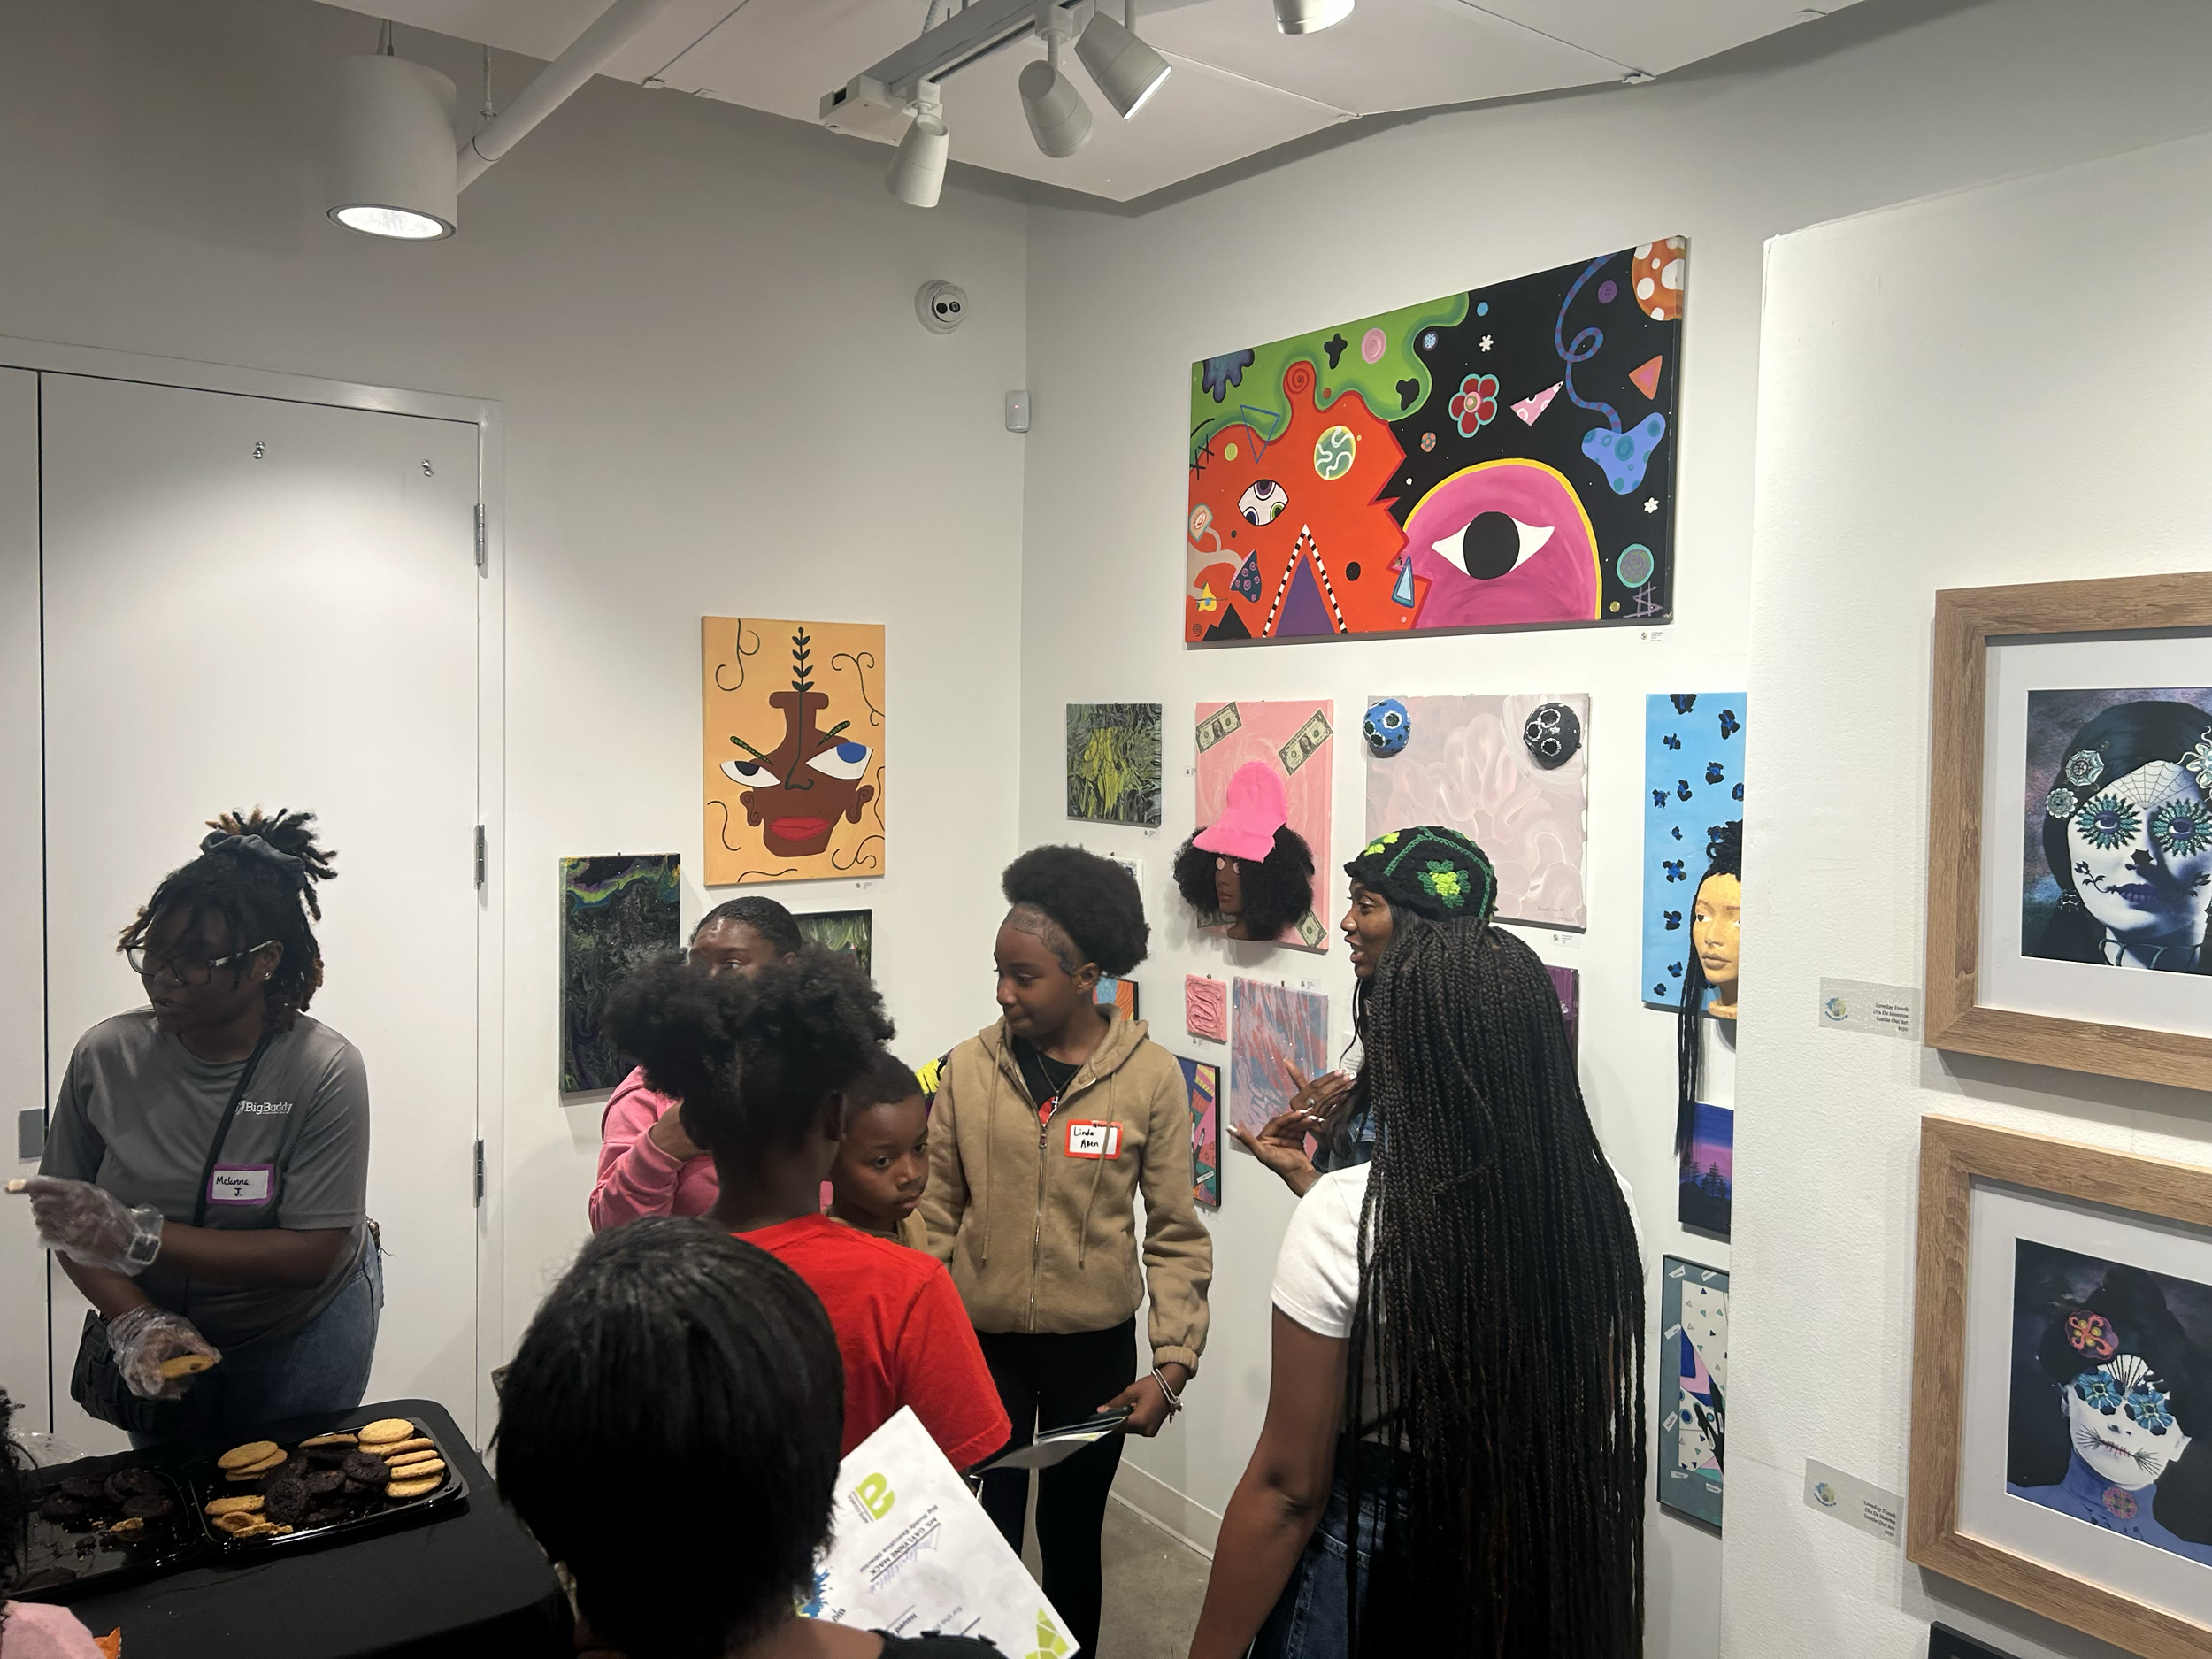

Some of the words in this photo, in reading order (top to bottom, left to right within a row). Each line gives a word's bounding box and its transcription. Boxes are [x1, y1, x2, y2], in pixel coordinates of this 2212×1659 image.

[1074, 1126, 1094, 1136] Linda
[927, 1504, 939, 1515] Big
[910, 1513, 929, 1530] Buddy
[882, 1529, 910, 1553] Executive
[859, 1552, 884, 1573] Director
[870, 1556, 892, 1575] MACK
[895, 1612, 918, 1635] Issued
